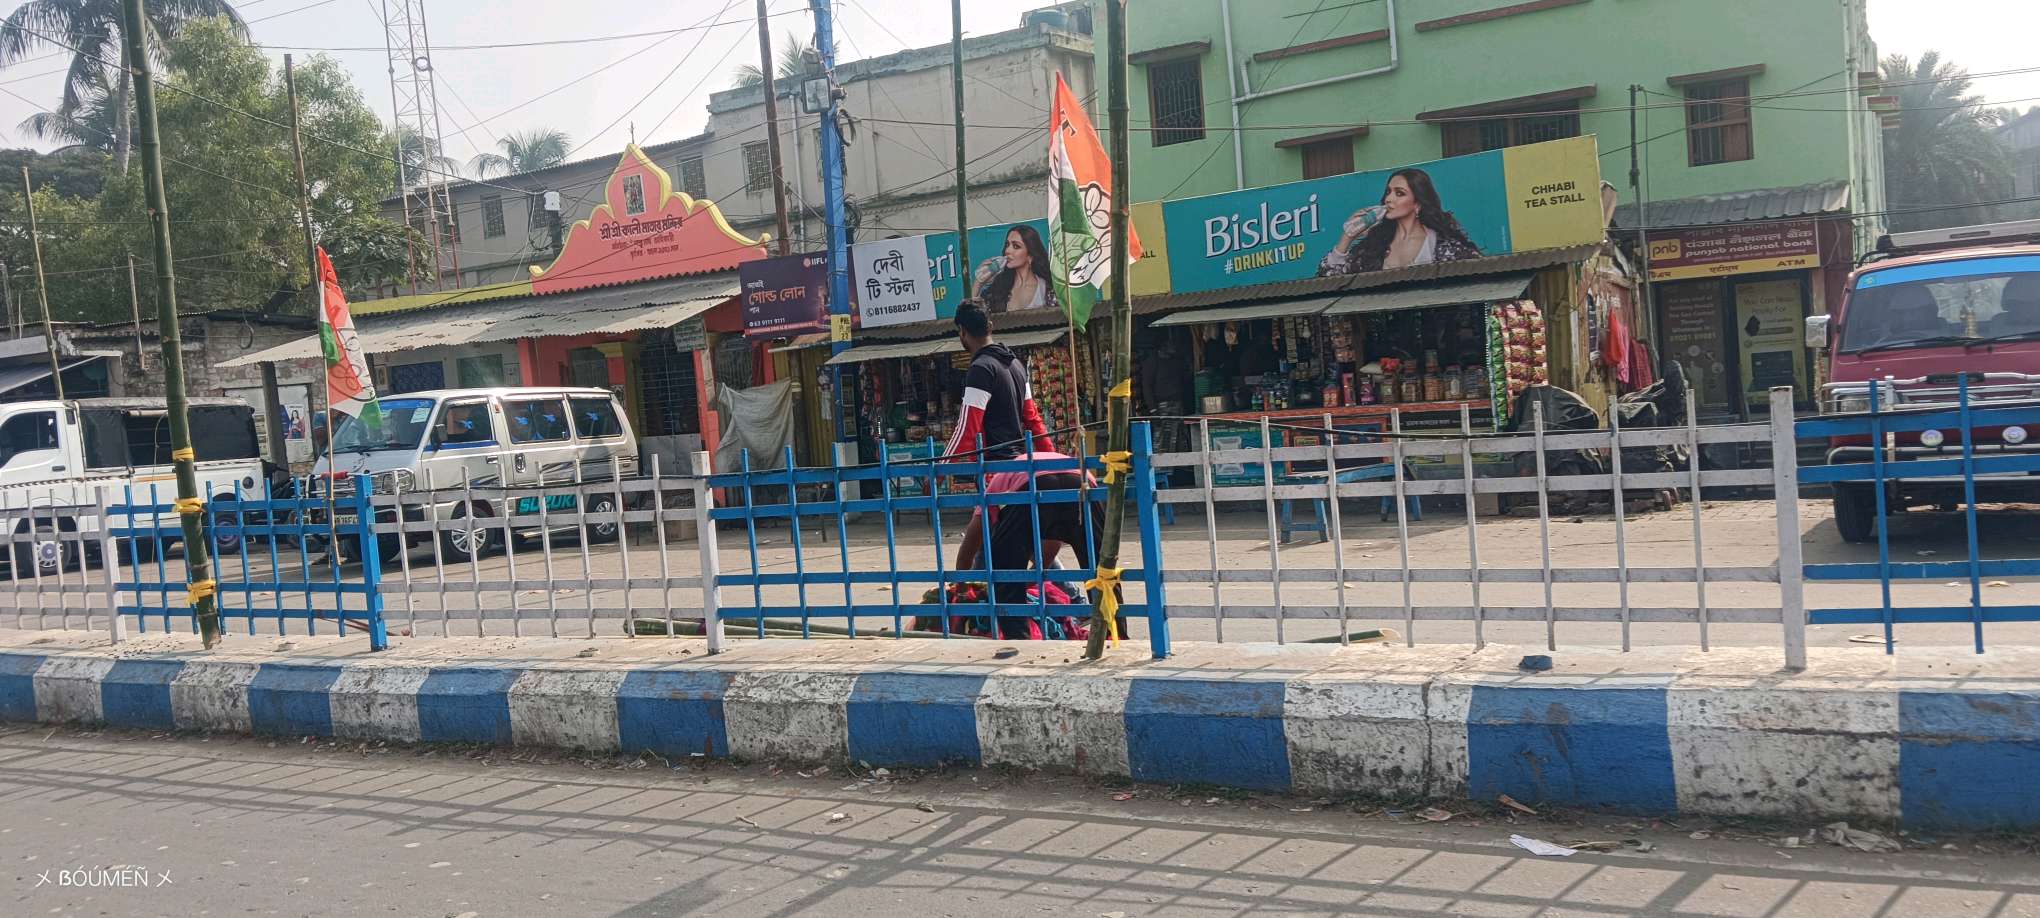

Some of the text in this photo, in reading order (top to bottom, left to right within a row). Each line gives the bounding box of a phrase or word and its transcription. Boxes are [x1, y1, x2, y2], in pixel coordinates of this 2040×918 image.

[1531, 181, 1576, 195] CHHABI
[1524, 193, 1585, 208] TEA STALL
[1204, 193, 1320, 258] Bisleri
[1224, 242, 1305, 275] #DRINKITUP
[1652, 242, 1678, 258] pnb
[1685, 246, 1727, 259] punjab
[1729, 242, 1780, 253] national
[1783, 239, 1814, 248] bank
[873, 250, 904, 274] দেবী
[1776, 259, 1806, 267] ATM
[749, 286, 806, 305] গোল্ড লোন
[865, 278, 882, 300] টি
[884, 276, 915, 295] স্টল
[875, 302, 920, 316] 8116882437
